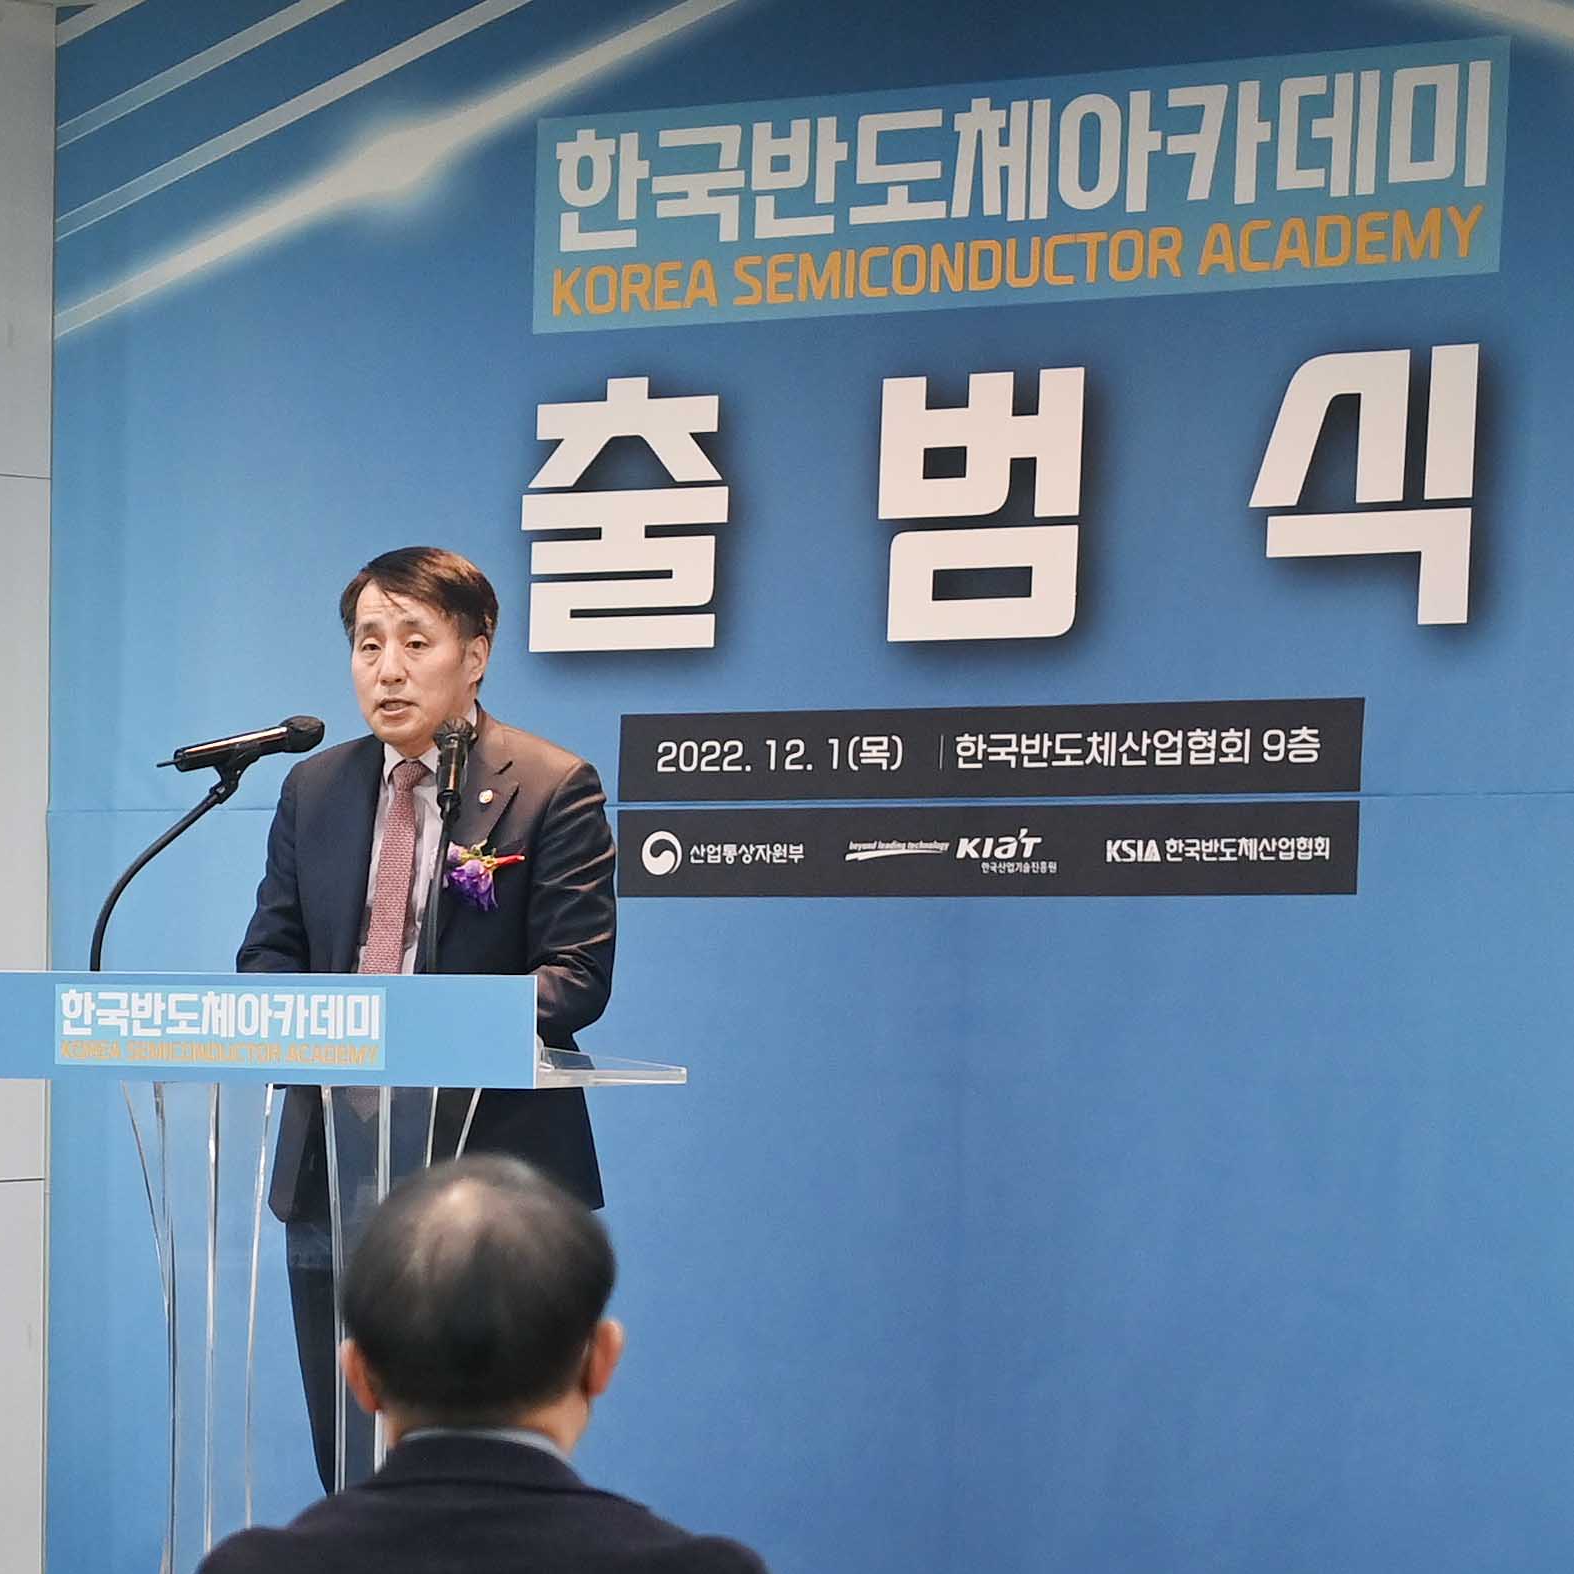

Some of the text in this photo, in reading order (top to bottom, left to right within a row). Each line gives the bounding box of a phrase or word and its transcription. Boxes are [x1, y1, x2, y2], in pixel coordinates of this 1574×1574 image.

[555, 59, 1493, 254] 한국반도체아카데미
[551, 203, 1485, 318] KOREA SEMICONDUCTOR ACADEMY
[657, 726, 1321, 772] 2022. 12. 1(목) 한국반도체산업협회 9층
[689, 843, 804, 864] 산업통상자원부
[1106, 839, 1161, 862] KSIA
[1165, 836, 1330, 862] 한국반도체산업협회
[61, 989, 380, 1040] 한국반도체아카데미
